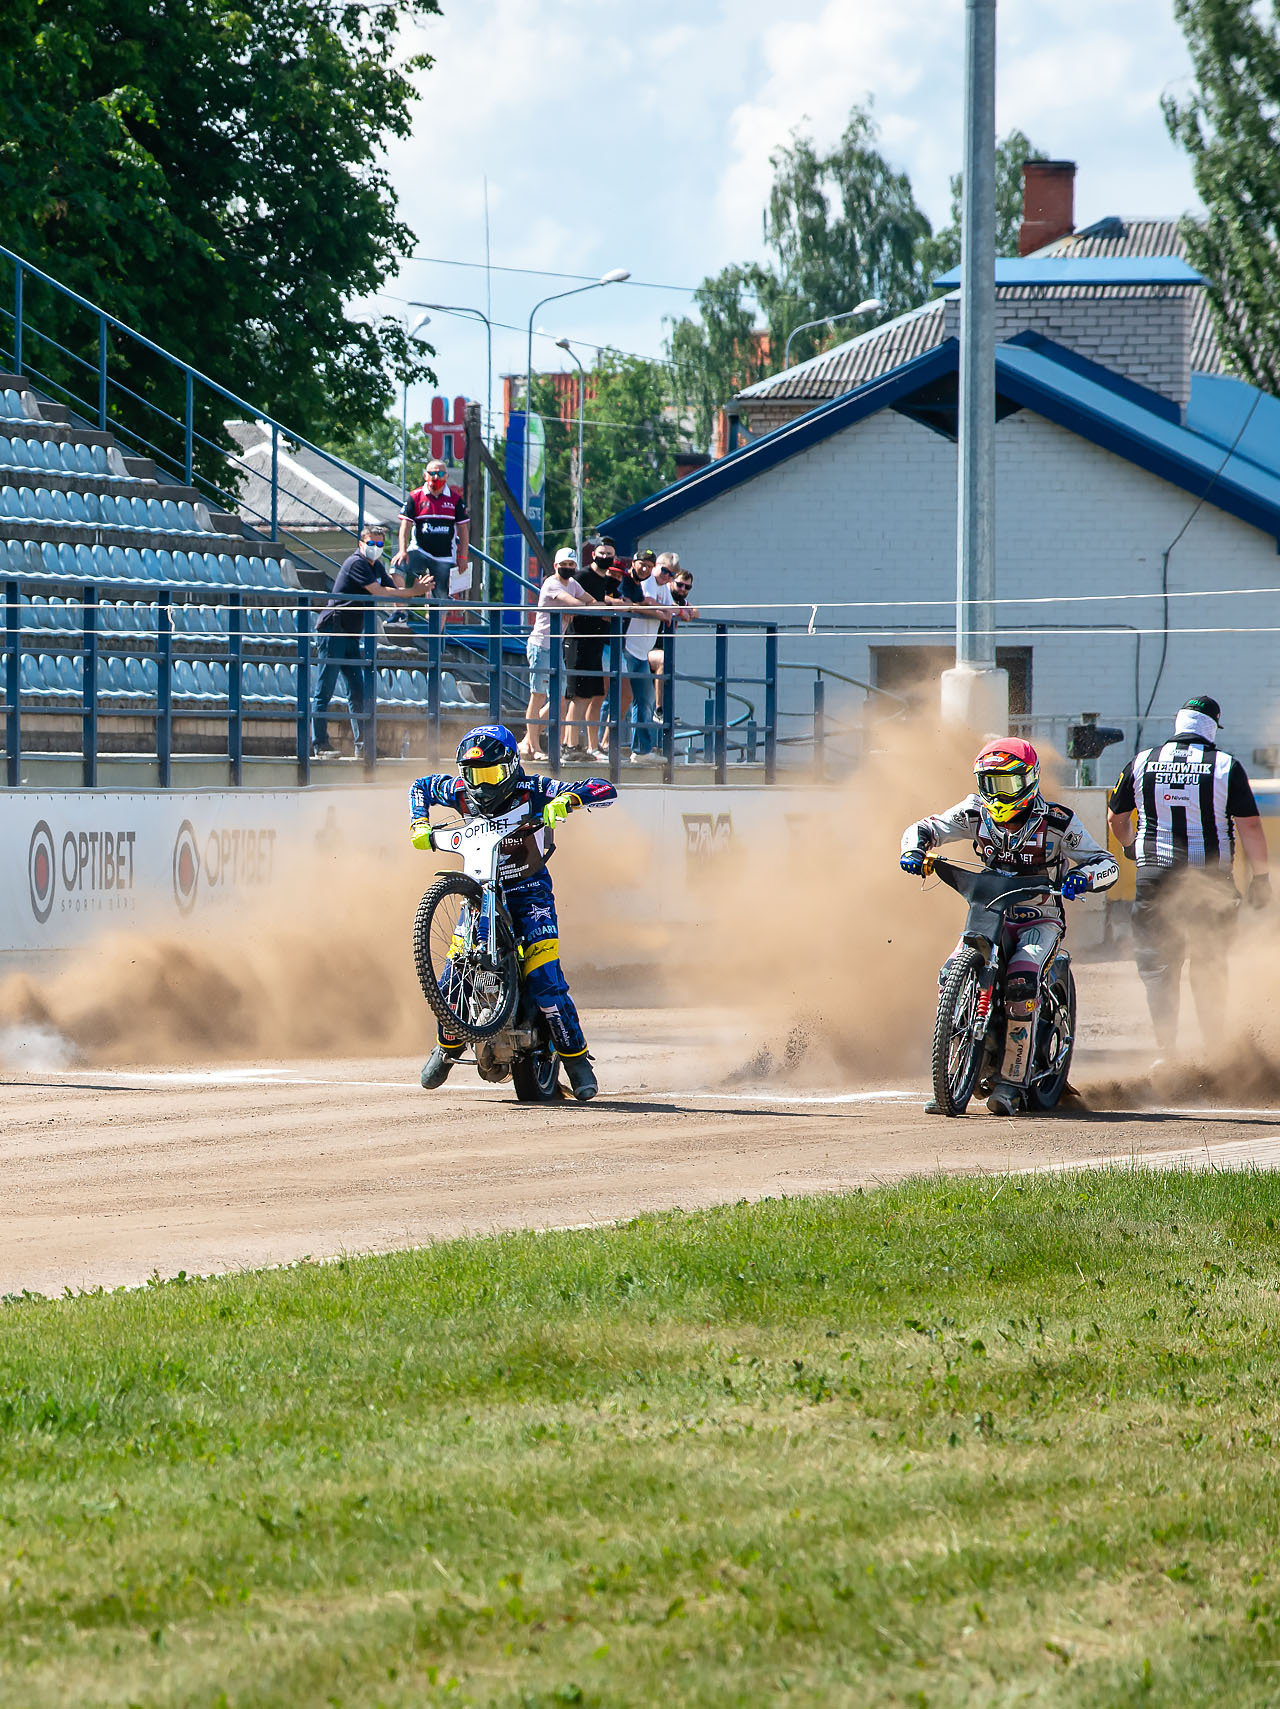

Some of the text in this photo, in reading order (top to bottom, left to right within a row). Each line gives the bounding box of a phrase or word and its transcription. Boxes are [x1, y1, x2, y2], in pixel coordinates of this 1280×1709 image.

[1146, 762, 1212, 775] KIEROWNIK
[1155, 772, 1200, 785] STARTU
[464, 817, 510, 839] OPTIBET
[61, 830, 136, 892] OPTIBET
